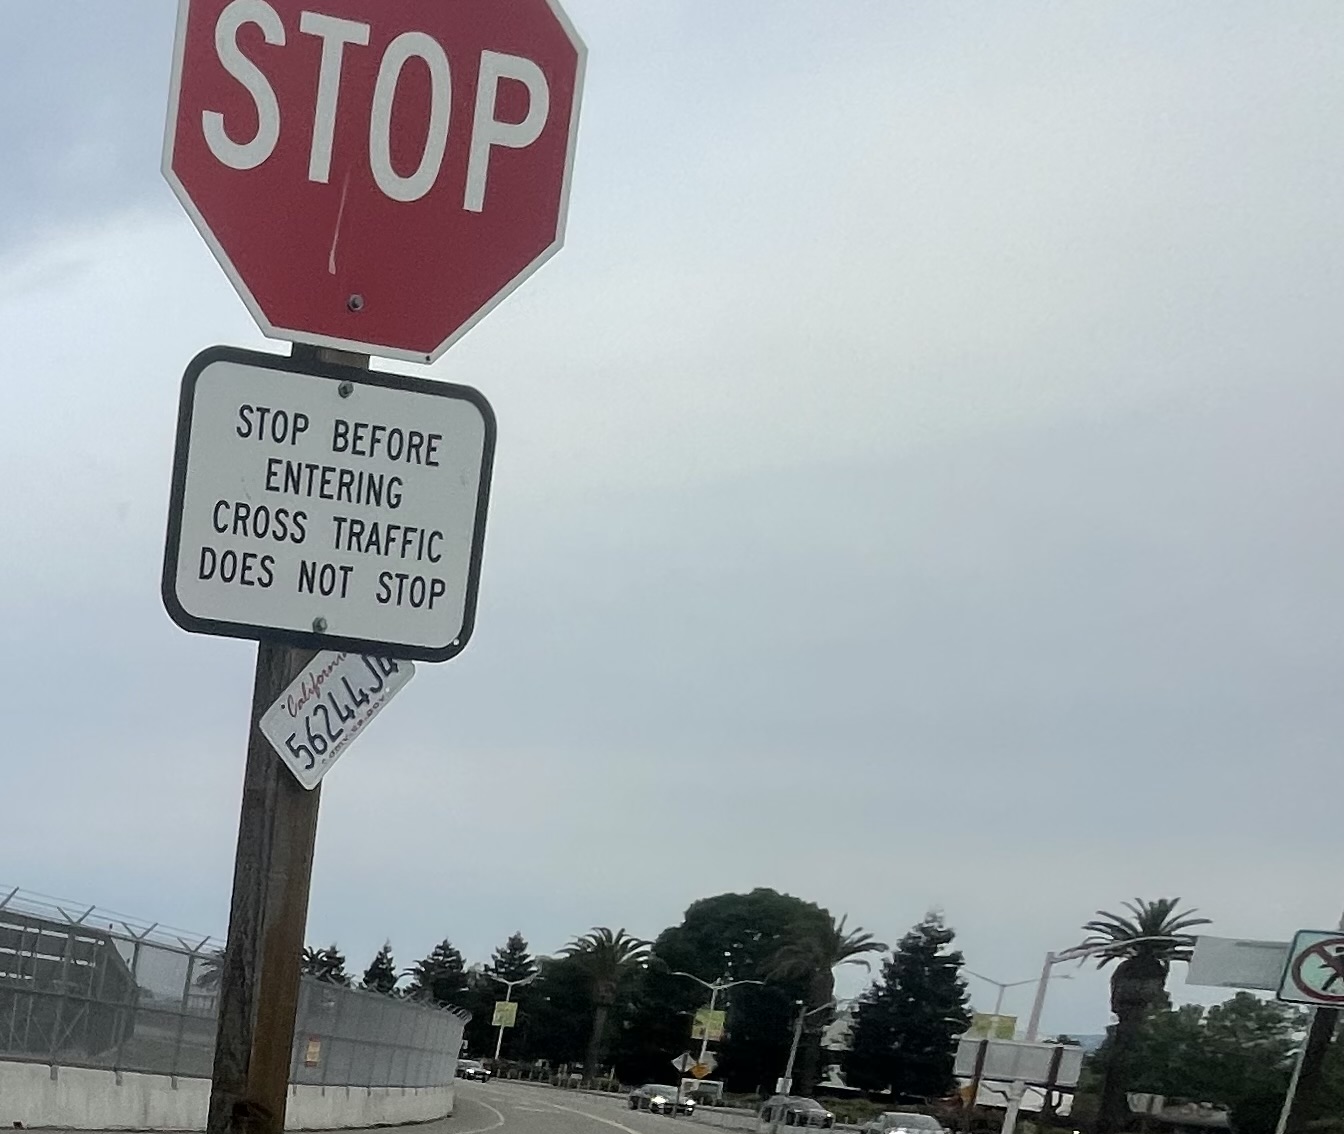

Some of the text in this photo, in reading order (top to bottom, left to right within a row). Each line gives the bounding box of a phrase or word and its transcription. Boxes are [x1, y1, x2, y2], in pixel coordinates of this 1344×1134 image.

[202, 0, 550, 213] STOP
[236, 404, 442, 467] STOP BEFORE
[265, 459, 403, 508] ENTERING
[212, 499, 443, 564] CROSS TRAFFIC
[198, 547, 446, 611] DOES NOT STOP
